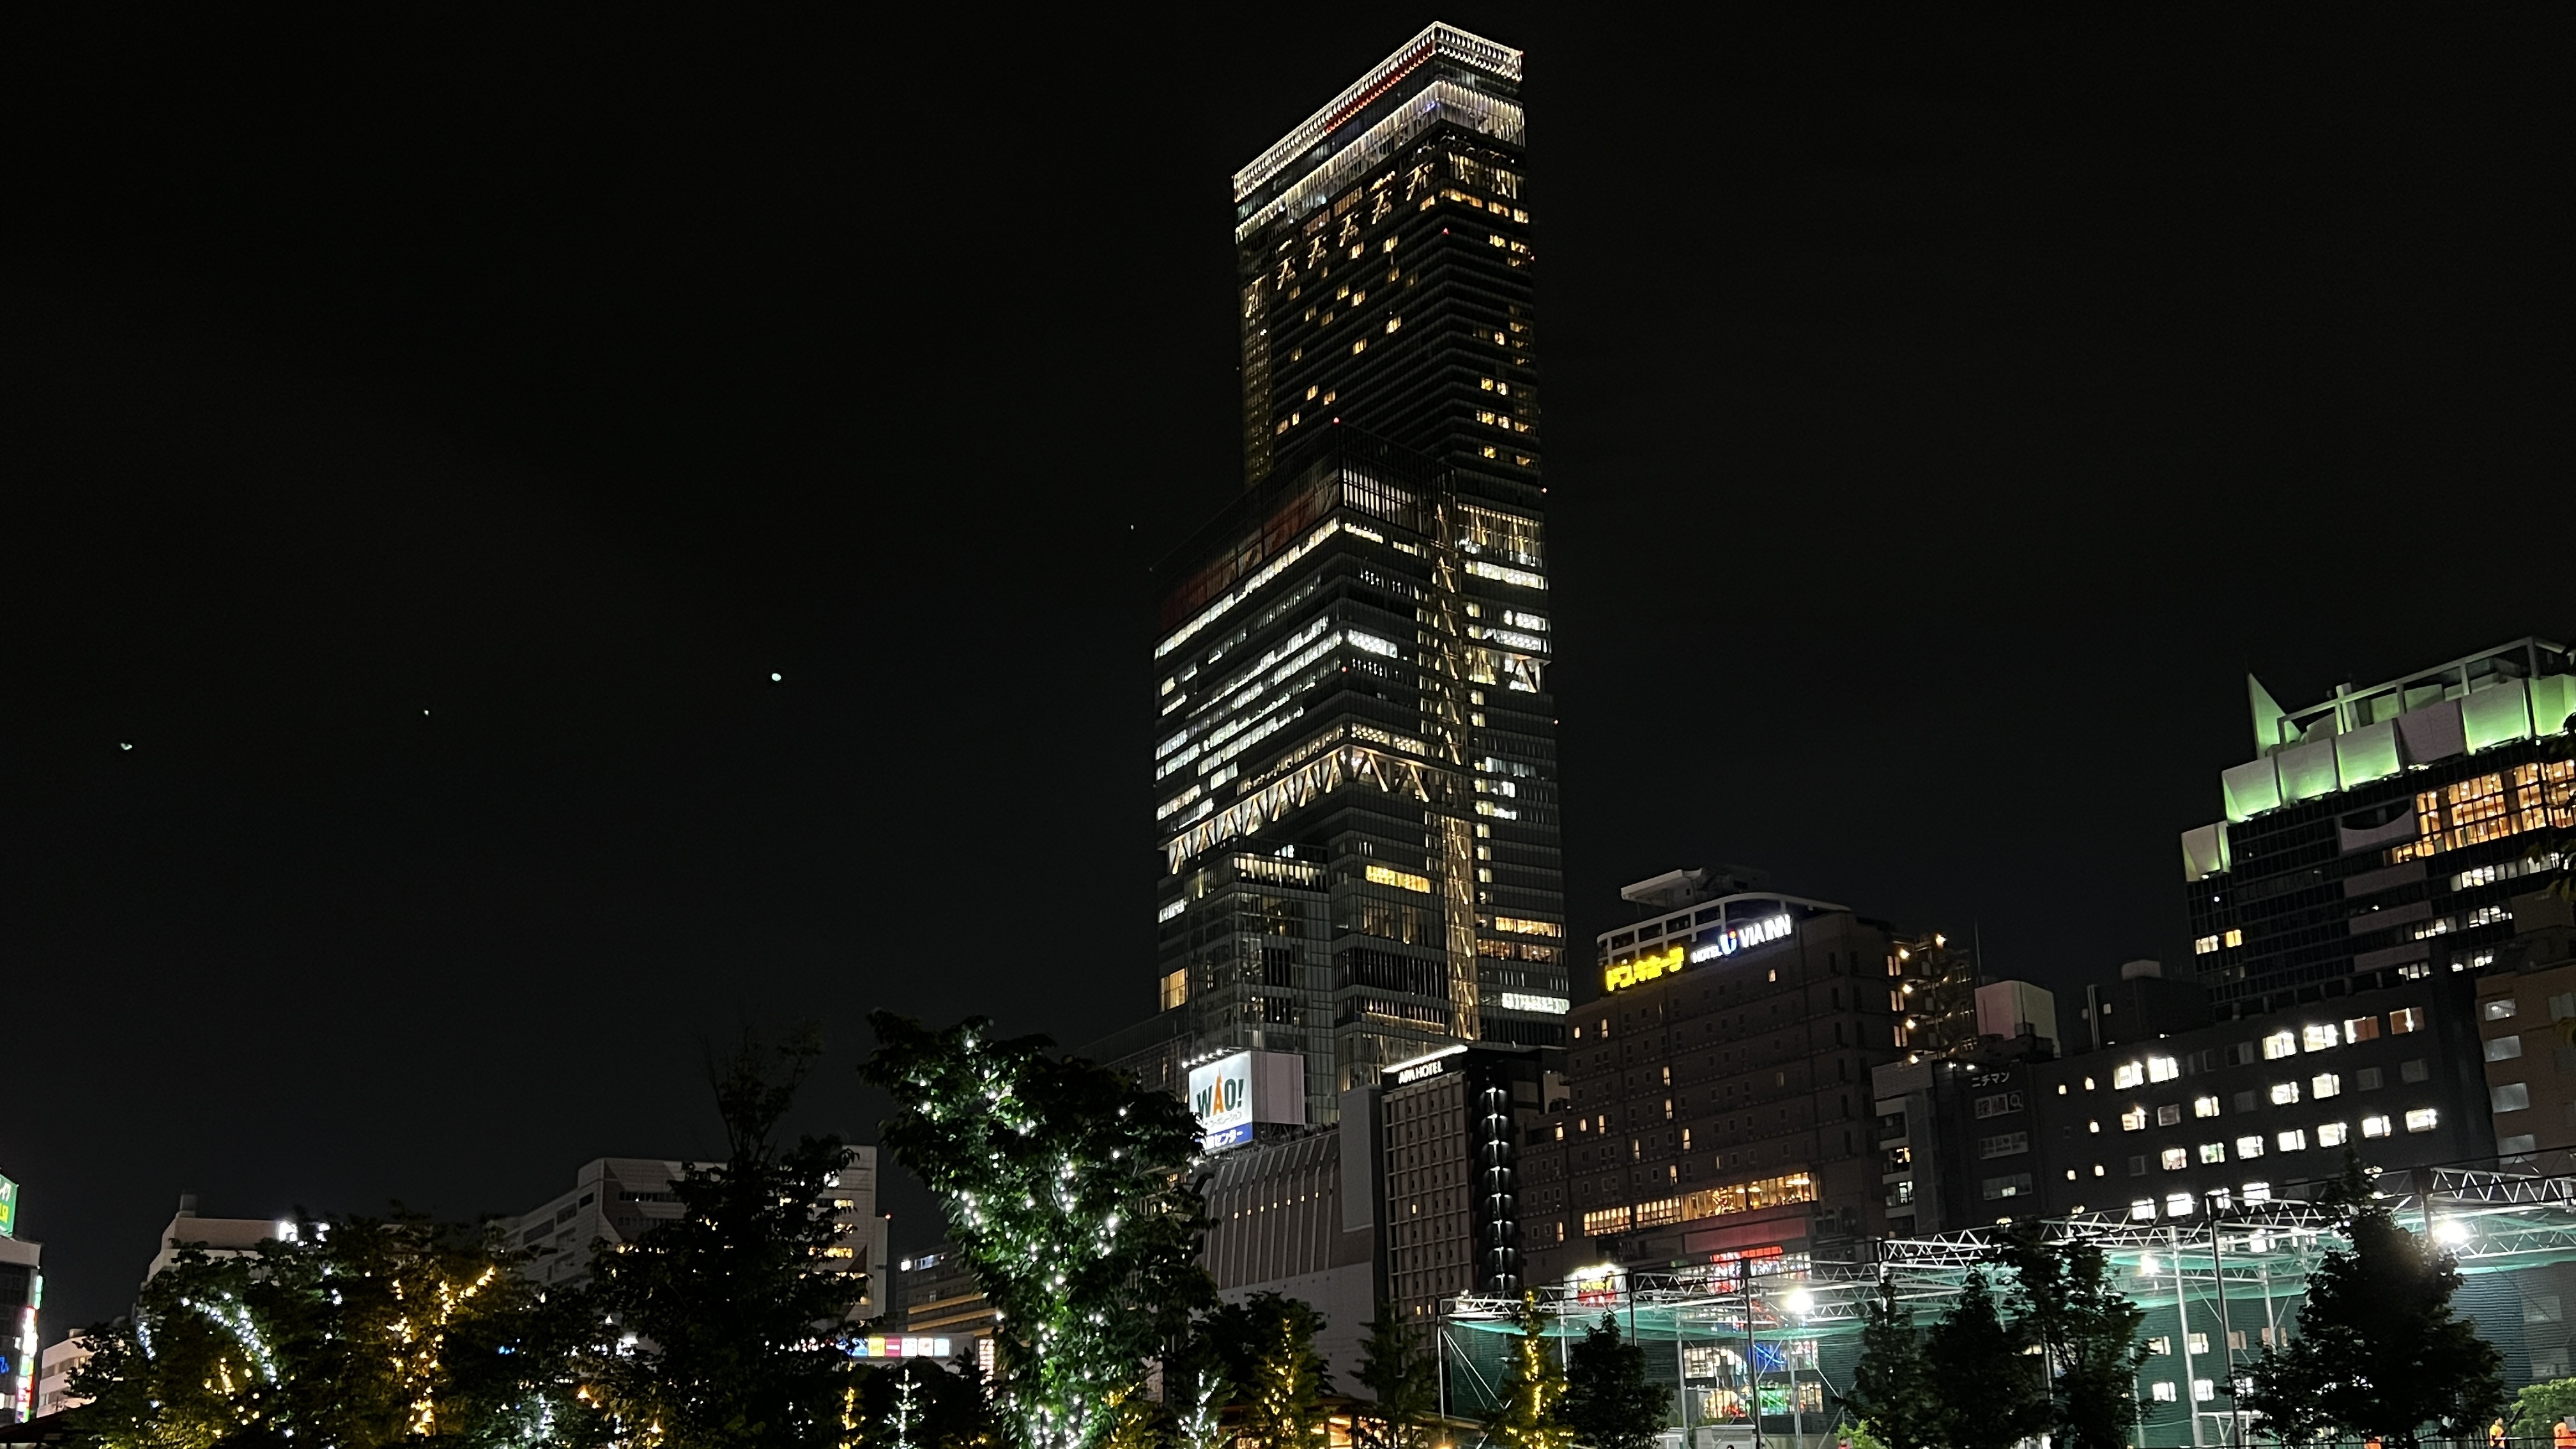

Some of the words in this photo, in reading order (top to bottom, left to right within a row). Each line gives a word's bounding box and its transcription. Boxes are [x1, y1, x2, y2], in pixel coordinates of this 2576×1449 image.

[1690, 945, 1723, 963] HOTEL
[1738, 923, 1765, 948] VIA
[1764, 914, 1791, 942] INN
[1415, 1060, 1443, 1079] HOTEL
[1972, 1072, 2010, 1087] ニチマン
[1197, 1066, 1245, 1118] WAO!
